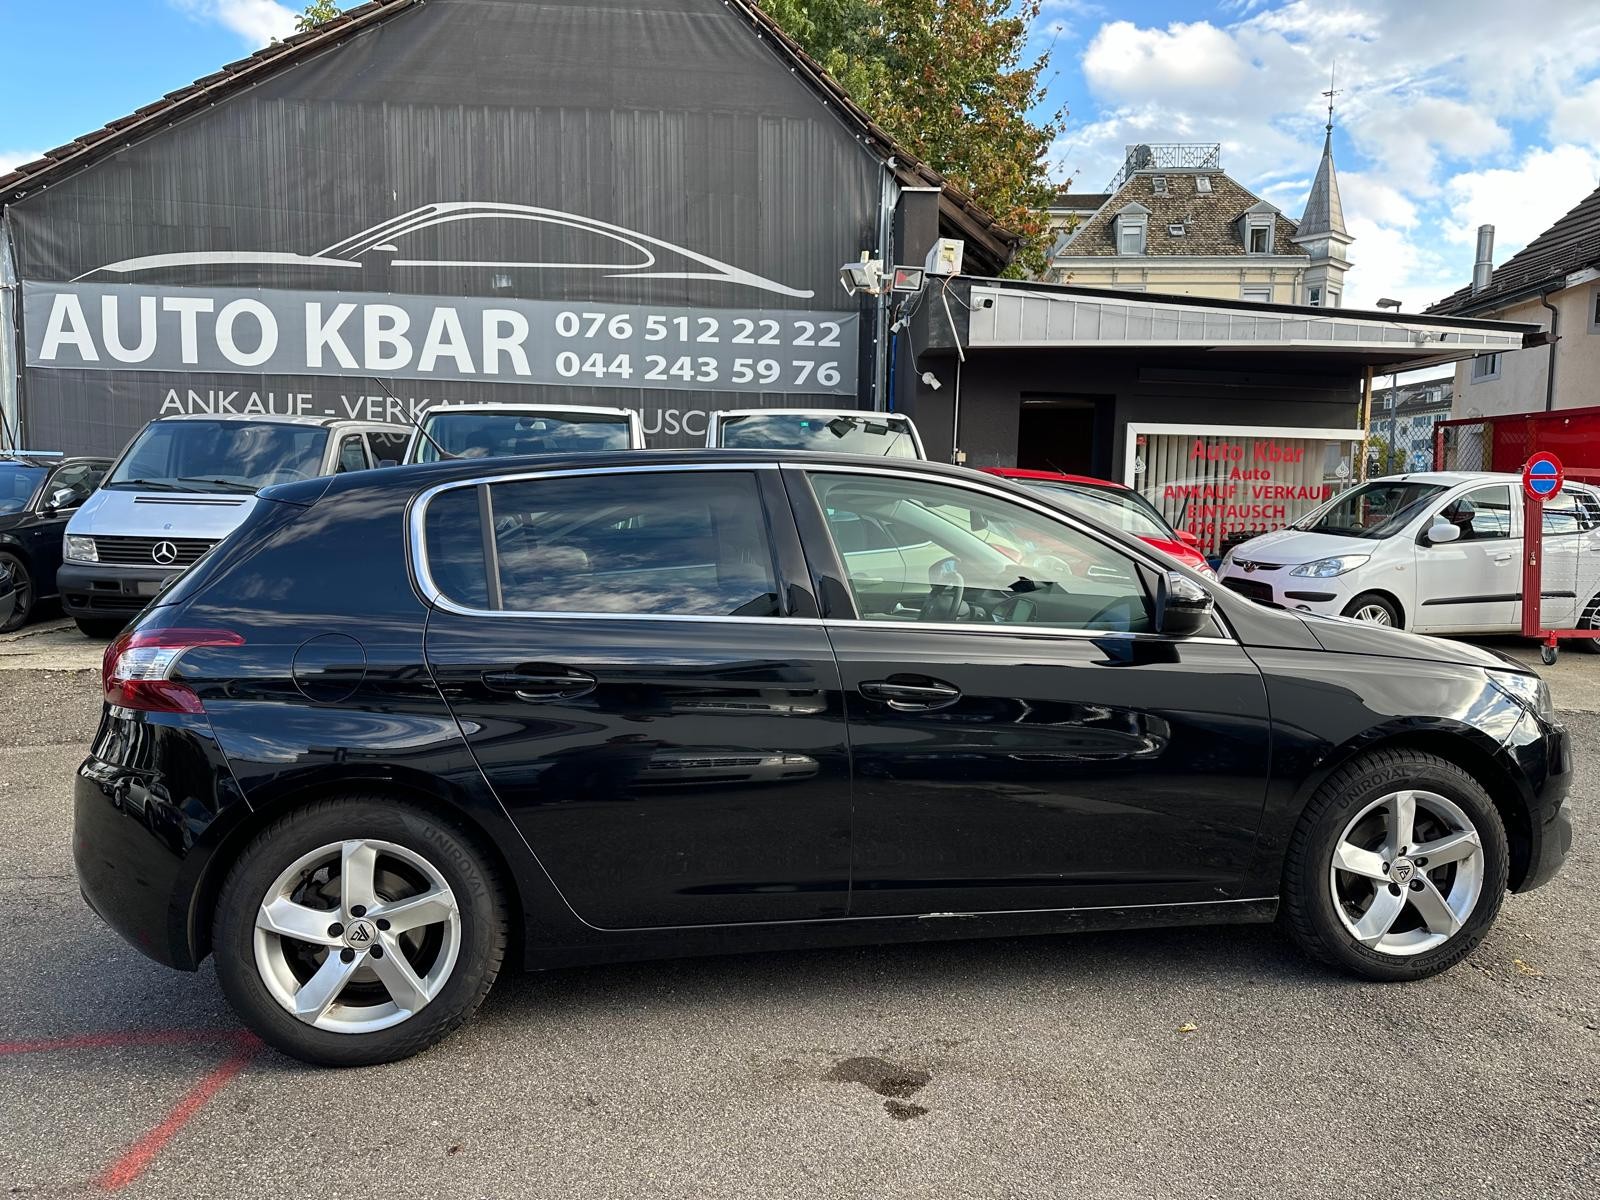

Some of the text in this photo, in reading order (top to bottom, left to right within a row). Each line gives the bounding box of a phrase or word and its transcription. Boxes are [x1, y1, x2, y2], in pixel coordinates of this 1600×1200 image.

[39, 294, 531, 376] AUTO KBAR
[555, 311, 841, 348] 076 512 22 22
[555, 351, 841, 386] 044 243 59 76
[160, 389, 312, 415] ANKAUF
[640, 408, 715, 435] USC
[1190, 439, 1304, 463] Auto Kbar
[1230, 467, 1271, 481] Auto
[1163, 485, 1238, 500] ANKAUF
[1187, 504, 1285, 519] EINTAUSCH
[1188, 522, 1215, 535] 076
[1338, 766, 1411, 809] UNIROYAL
[423, 826, 485, 896] UNIROYAL
